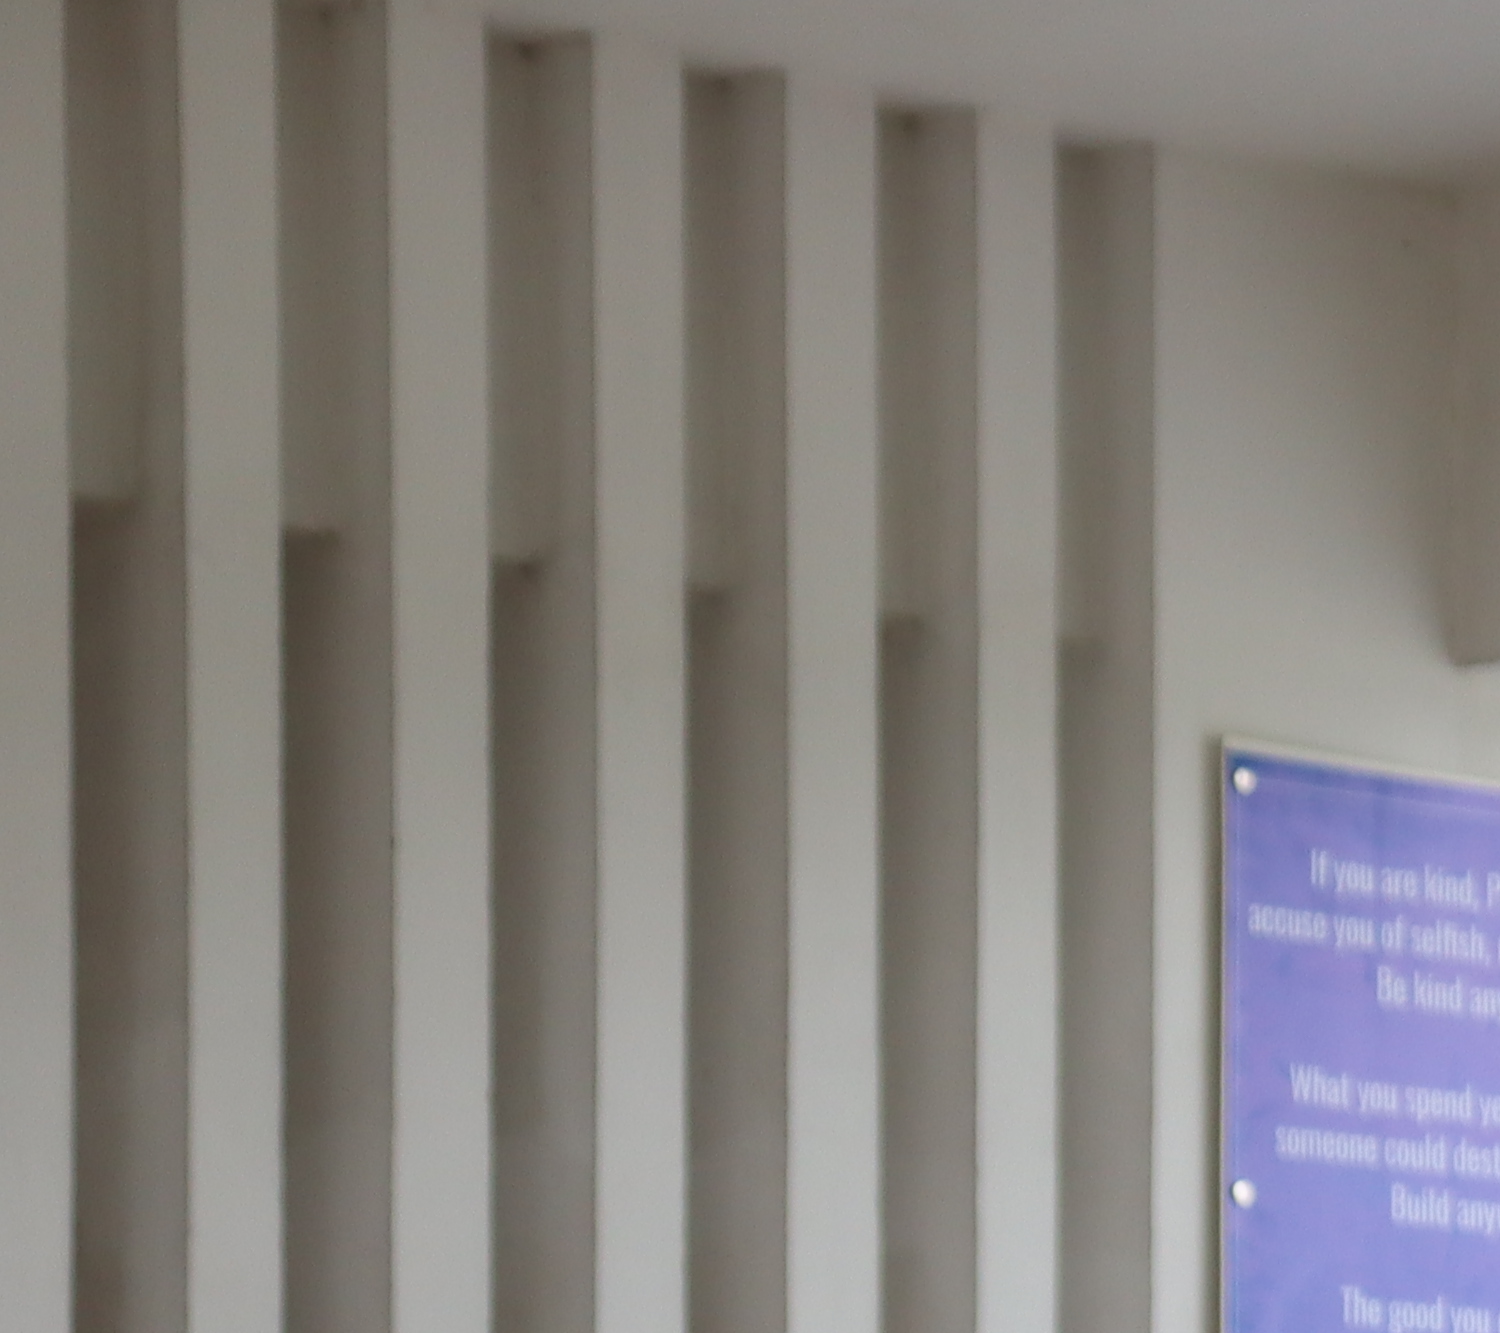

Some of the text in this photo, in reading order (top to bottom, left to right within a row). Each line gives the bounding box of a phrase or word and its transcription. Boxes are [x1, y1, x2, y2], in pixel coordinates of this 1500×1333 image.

[1310, 848, 1330, 887] If
[1334, 859, 1374, 895] you
[1380, 867, 1417, 898] are
[1248, 904, 1328, 940] accuse
[1334, 917, 1374, 950] you
[1381, 918, 1403, 948] of
[1376, 965, 1407, 1010] Be
[1414, 973, 1462, 1012] kind
[1289, 1063, 1350, 1106] What
[1357, 1078, 1398, 1113] you
[1404, 1083, 1472, 1122] spend
[1276, 1126, 1377, 1163] someone
[1384, 1134, 1446, 1170] could
[1390, 1182, 1450, 1225] Build
[1342, 1284, 1382, 1328] The
